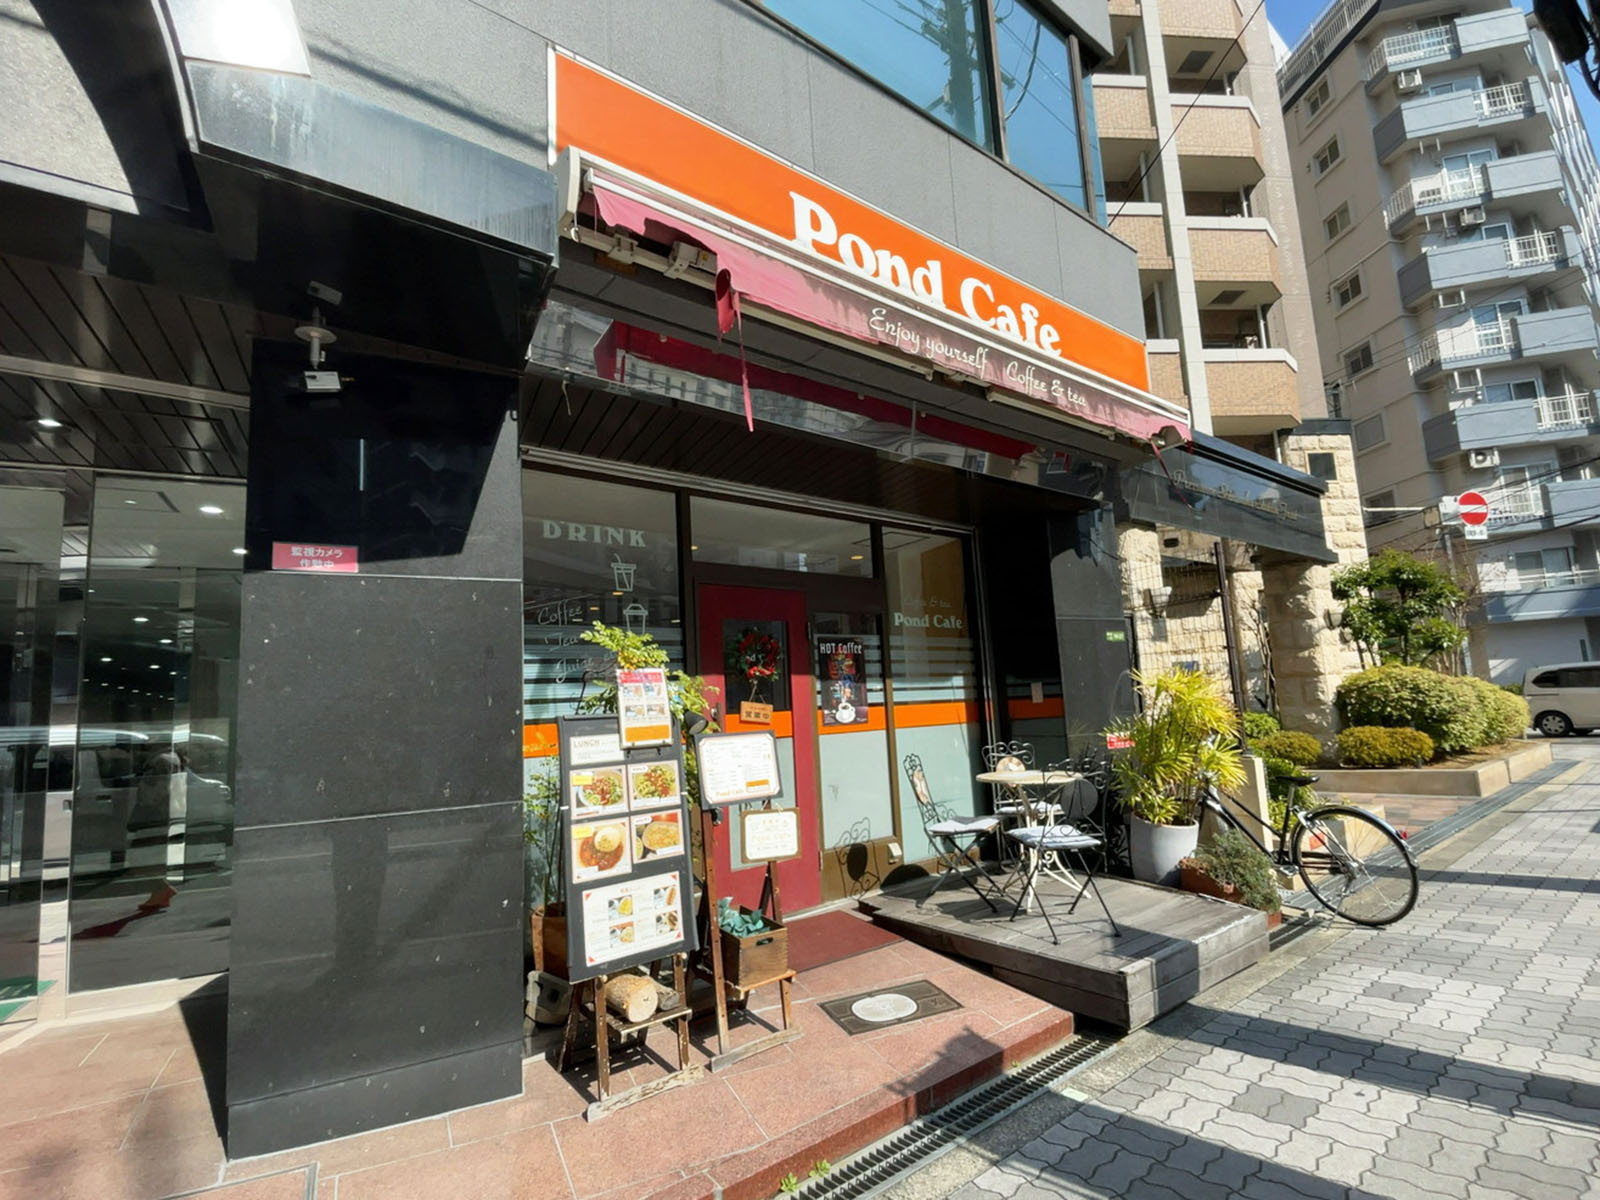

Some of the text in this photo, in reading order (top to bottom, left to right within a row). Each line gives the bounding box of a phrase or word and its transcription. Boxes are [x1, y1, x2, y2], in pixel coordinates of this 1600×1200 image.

[789, 191, 1062, 358] Pond Cafe
[869, 307, 989, 381] Enjoy yourself
[1006, 361, 1087, 407] Coffee & tea
[541, 519, 647, 548] DRINK
[538, 599, 583, 627] Coffee
[893, 612, 963, 629] Pond Cafe
[820, 642, 862, 654] HOT Coffee
